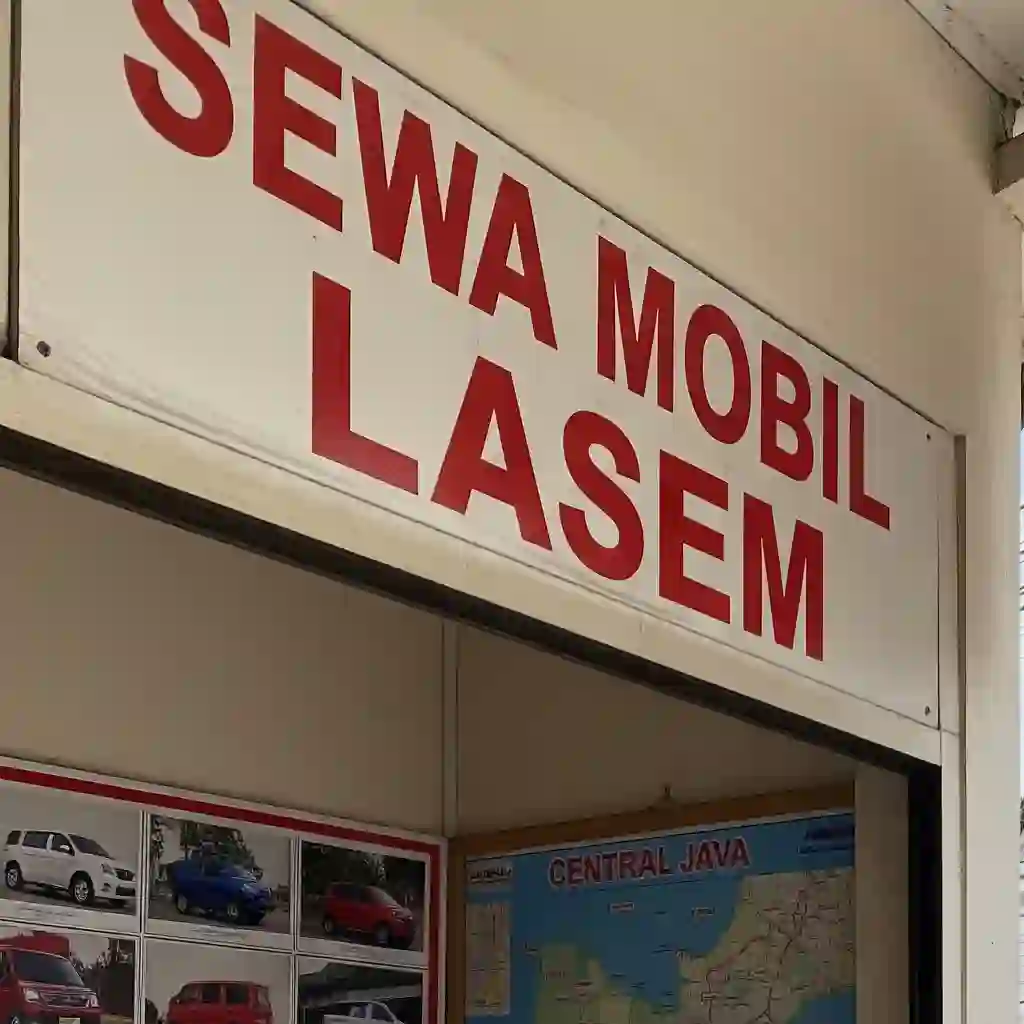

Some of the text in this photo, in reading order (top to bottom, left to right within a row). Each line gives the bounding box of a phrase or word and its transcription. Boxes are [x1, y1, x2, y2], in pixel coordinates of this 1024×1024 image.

[124, 0, 890, 529] SEWA MOBIL
[312, 271, 823, 661] LASEM
[549, 845, 674, 888] CENTRAL
[679, 837, 750, 873] JAVA
